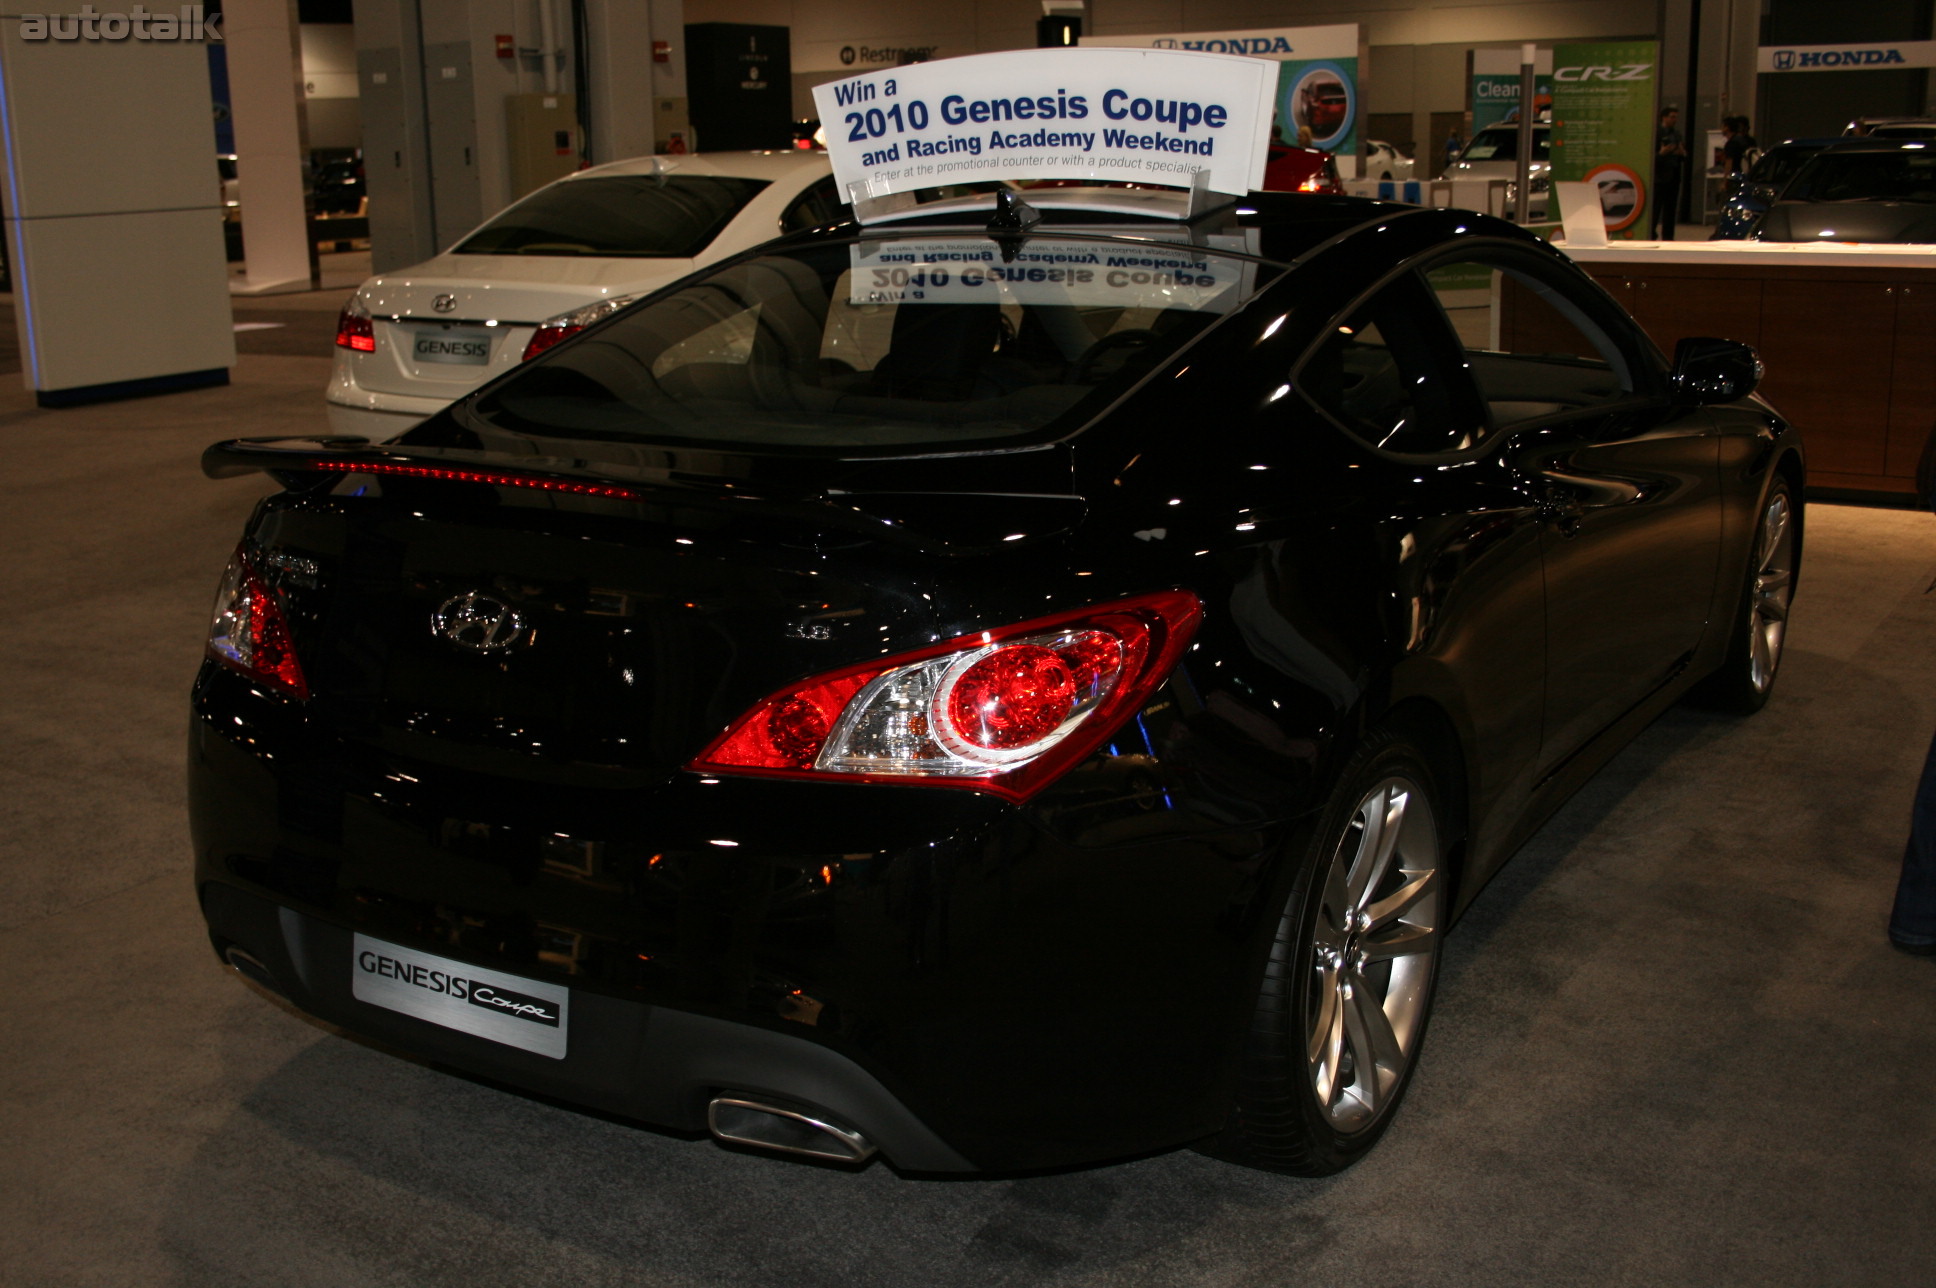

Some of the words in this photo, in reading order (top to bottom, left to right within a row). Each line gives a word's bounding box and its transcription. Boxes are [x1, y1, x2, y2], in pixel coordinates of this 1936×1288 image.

[1182, 37, 1293, 55] HONDA
[1799, 49, 1905, 67] HONDA
[1554, 64, 1653, 82] CR-Z
[834, 80, 876, 107] Win
[884, 79, 897, 97] a
[1476, 80, 1520, 97] Clean
[845, 100, 929, 142] 2010
[941, 88, 1088, 125] Genesis
[1102, 88, 1227, 133] Coupe
[862, 143, 900, 167] and
[906, 135, 982, 158] Racing
[989, 129, 1095, 151] Academy
[1102, 128, 1213, 156] Weekend
[874, 171, 900, 183] Enter
[904, 168, 914, 177] at
[917, 165, 933, 175] the
[937, 157, 999, 175] promotional
[1002, 156, 1044, 167] counter
[1047, 157, 1058, 165] or
[1062, 154, 1084, 165] with
[1088, 157, 1095, 166] a
[1098, 157, 1142, 169] product
[1145, 161, 1202, 174] specialist
[416, 340, 487, 357] GENESIS
[359, 951, 468, 999] GENESIS
[473, 988, 556, 1019] Coupe
